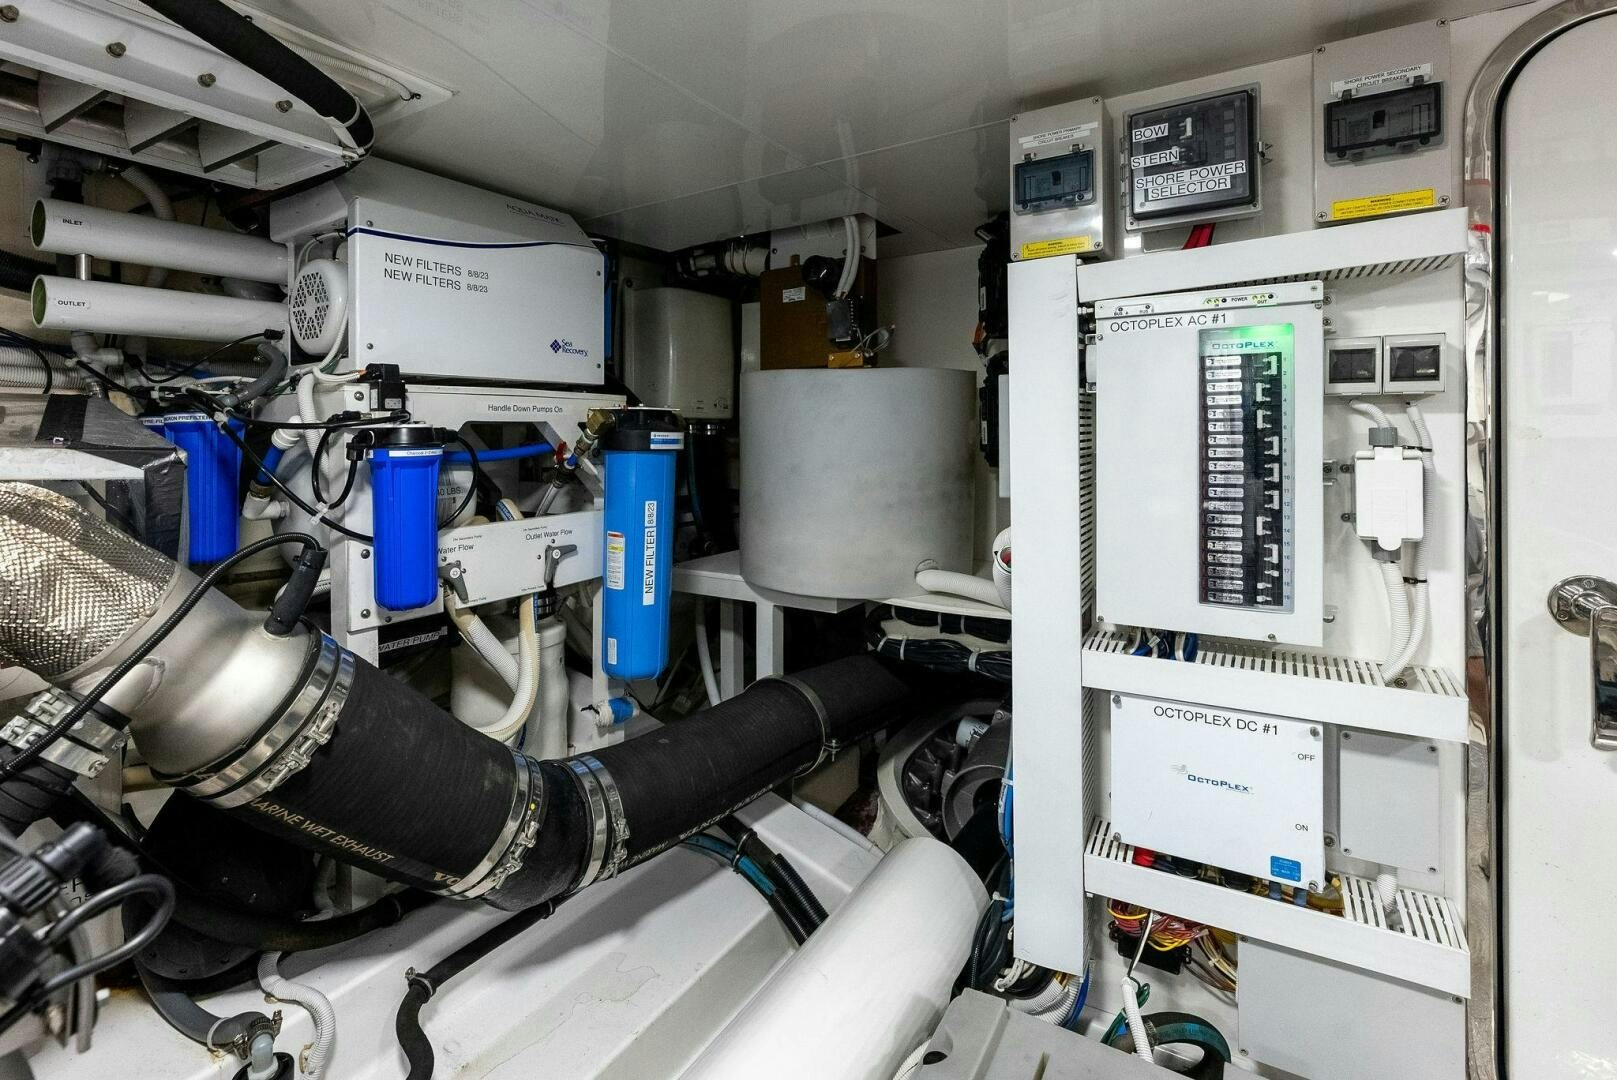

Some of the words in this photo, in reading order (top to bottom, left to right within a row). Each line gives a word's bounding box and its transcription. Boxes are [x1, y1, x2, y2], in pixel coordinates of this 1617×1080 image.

[1344, 77, 1363, 85] SHORE
[1365, 72, 1385, 81] POWER
[1386, 65, 1421, 76] SECONDARY
[1356, 80, 1380, 88] CIRCUIT
[1382, 74, 1408, 83] BREAKER
[1134, 124, 1167, 141] BOW
[1132, 149, 1178, 168] STERN
[1136, 171, 1185, 189] SHORE
[1189, 161, 1245, 180] POWER
[1151, 178, 1228, 199] SELECTOR
[62, 218, 83, 226] INLET
[385, 252, 413, 267] NEW
[416, 258, 462, 277] FILTERS
[467, 269, 489, 280] 8/8/23
[384, 268, 413, 282] NEW
[415, 273, 461, 291] FILTERS
[466, 283, 488, 293] 8/8/23
[1110, 316, 1183, 332] OCTOPLEX
[1187, 314, 1207, 326] AC
[1211, 313, 1226, 324] #1
[561, 338, 573, 348] Sea
[488, 404, 512, 412] Handle
[512, 404, 531, 412] Down
[532, 405, 553, 413] Pumps
[647, 502, 655, 525] 8/8/23
[526, 532, 543, 541] Outlet
[543, 530, 560, 538] Water
[645, 530, 655, 567] FILTER
[644, 569, 654, 594] NEW
[413, 631, 441, 645] PUMP
[1153, 706, 1232, 728] OCTOPLEX
[1236, 718, 1258, 732] DC
[1262, 723, 1278, 736] #1
[1297, 753, 1315, 761] OFF
[1295, 823, 1309, 832] ON
[301, 820, 336, 838] WET
[330, 834, 395, 863] EXHAUST
